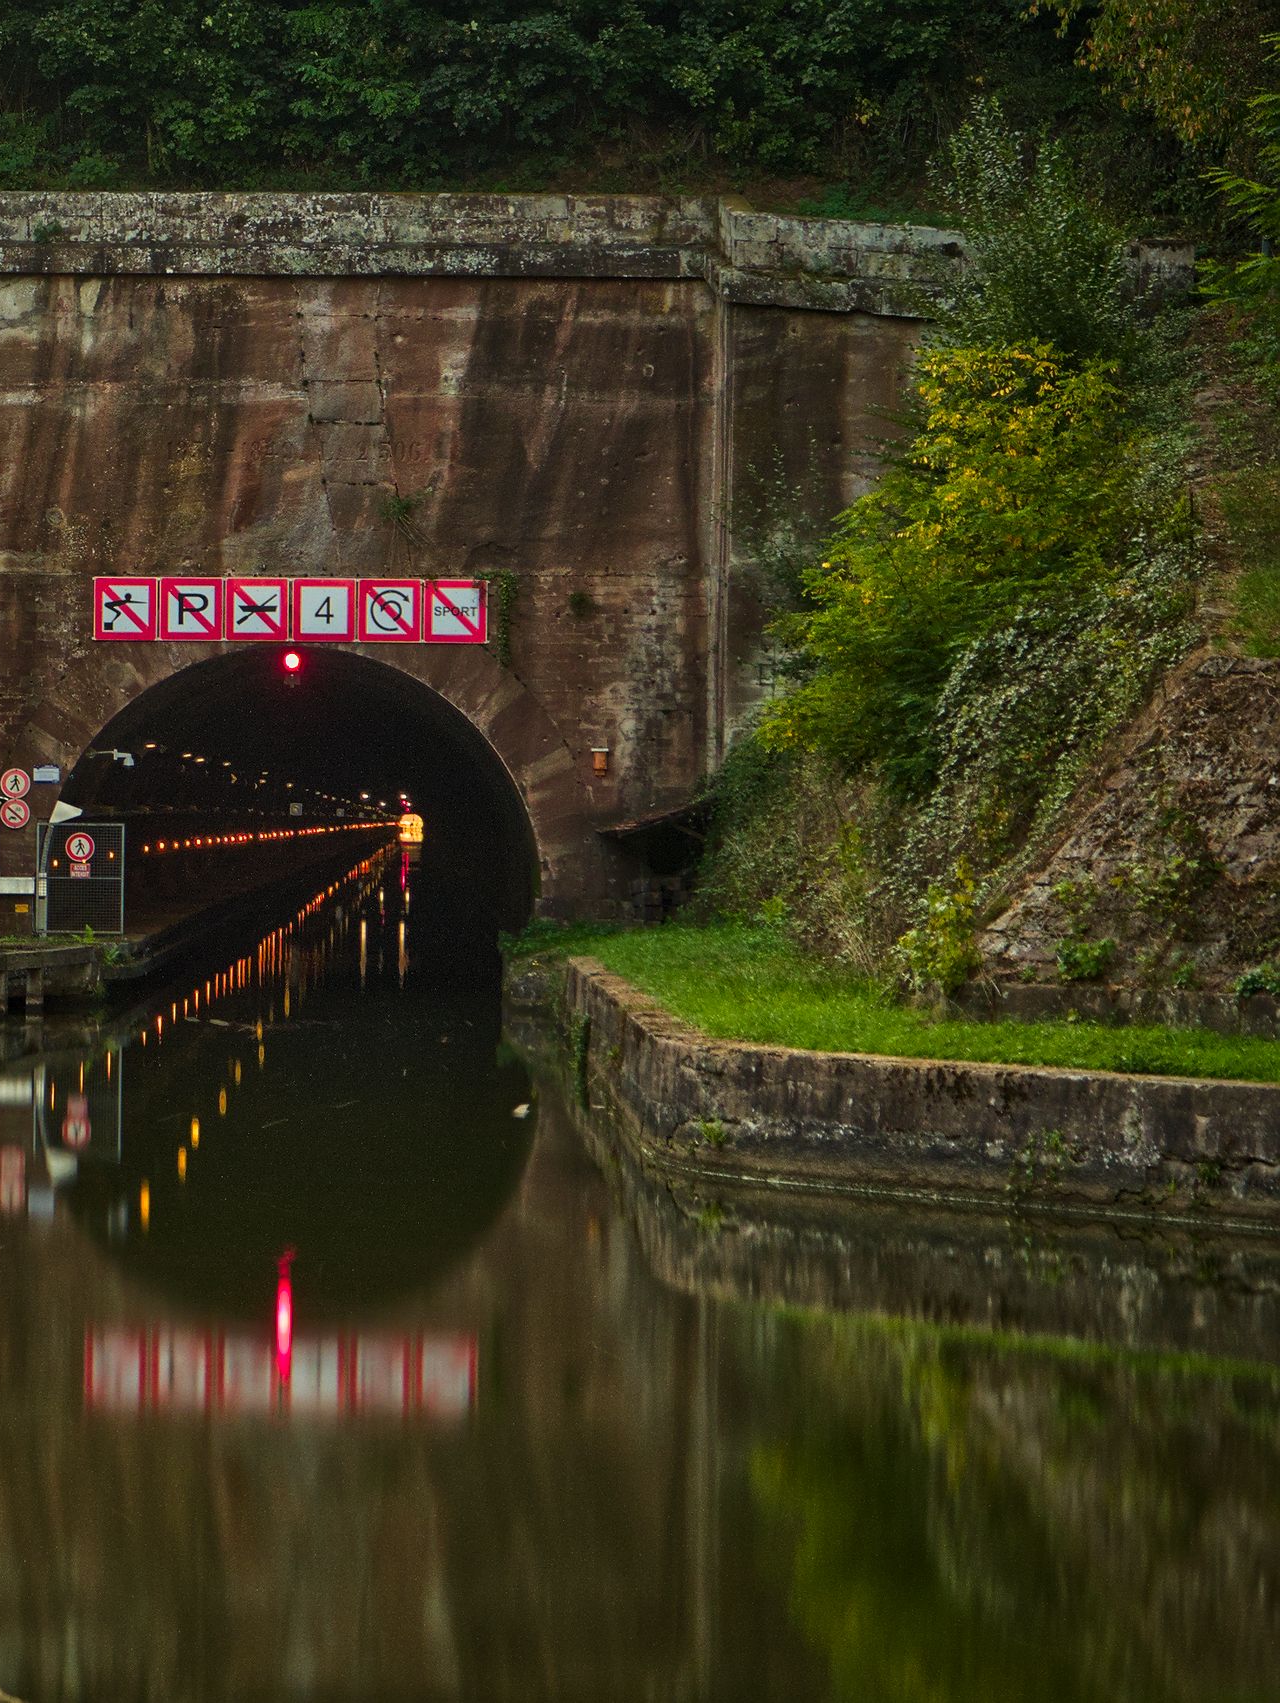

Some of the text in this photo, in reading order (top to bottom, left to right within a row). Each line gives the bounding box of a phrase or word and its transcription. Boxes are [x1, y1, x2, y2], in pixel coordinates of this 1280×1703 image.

[178, 593, 209, 625] P
[315, 596, 334, 624] 4
[434, 606, 478, 617] SPORT
